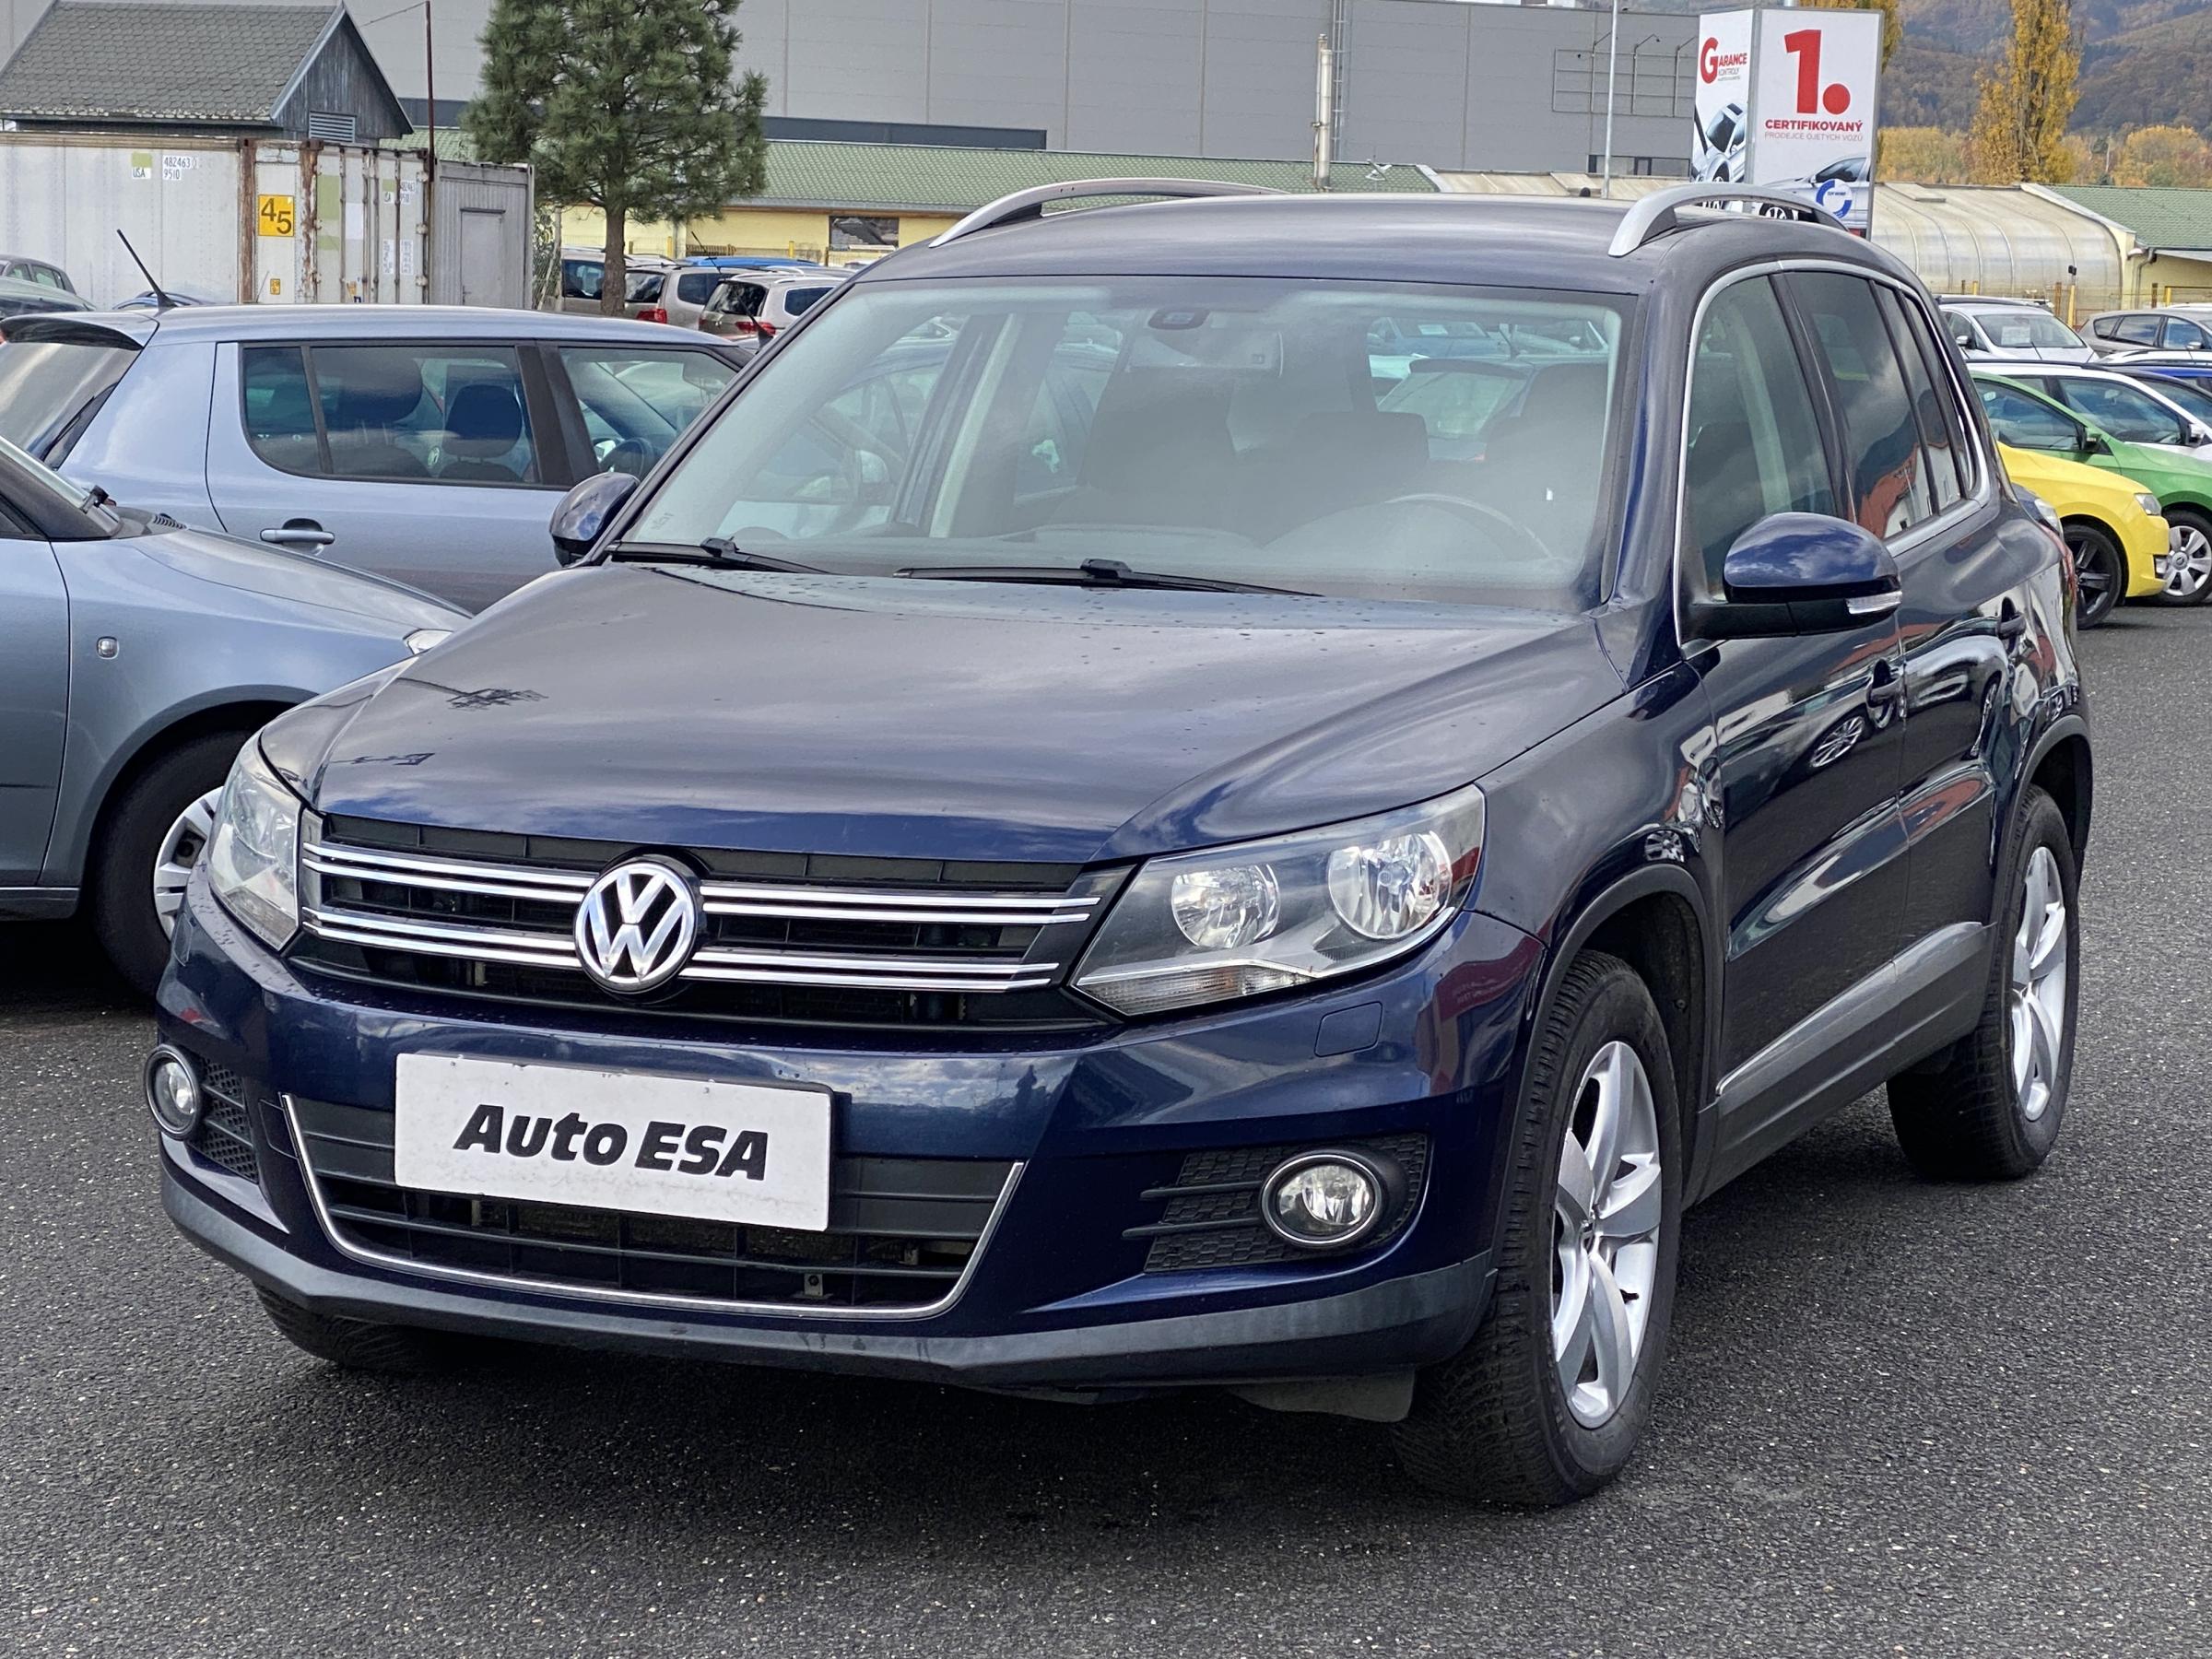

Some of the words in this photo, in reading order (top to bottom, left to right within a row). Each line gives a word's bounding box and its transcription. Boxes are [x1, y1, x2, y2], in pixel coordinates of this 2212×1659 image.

[1700, 37, 1747, 84] GARANCE
[1784, 29, 1851, 115] 1.
[1765, 119, 1863, 132] CERTIFIKOVANÝ
[453, 1103, 628, 1167] Auto
[634, 1120, 769, 1182] ESA
